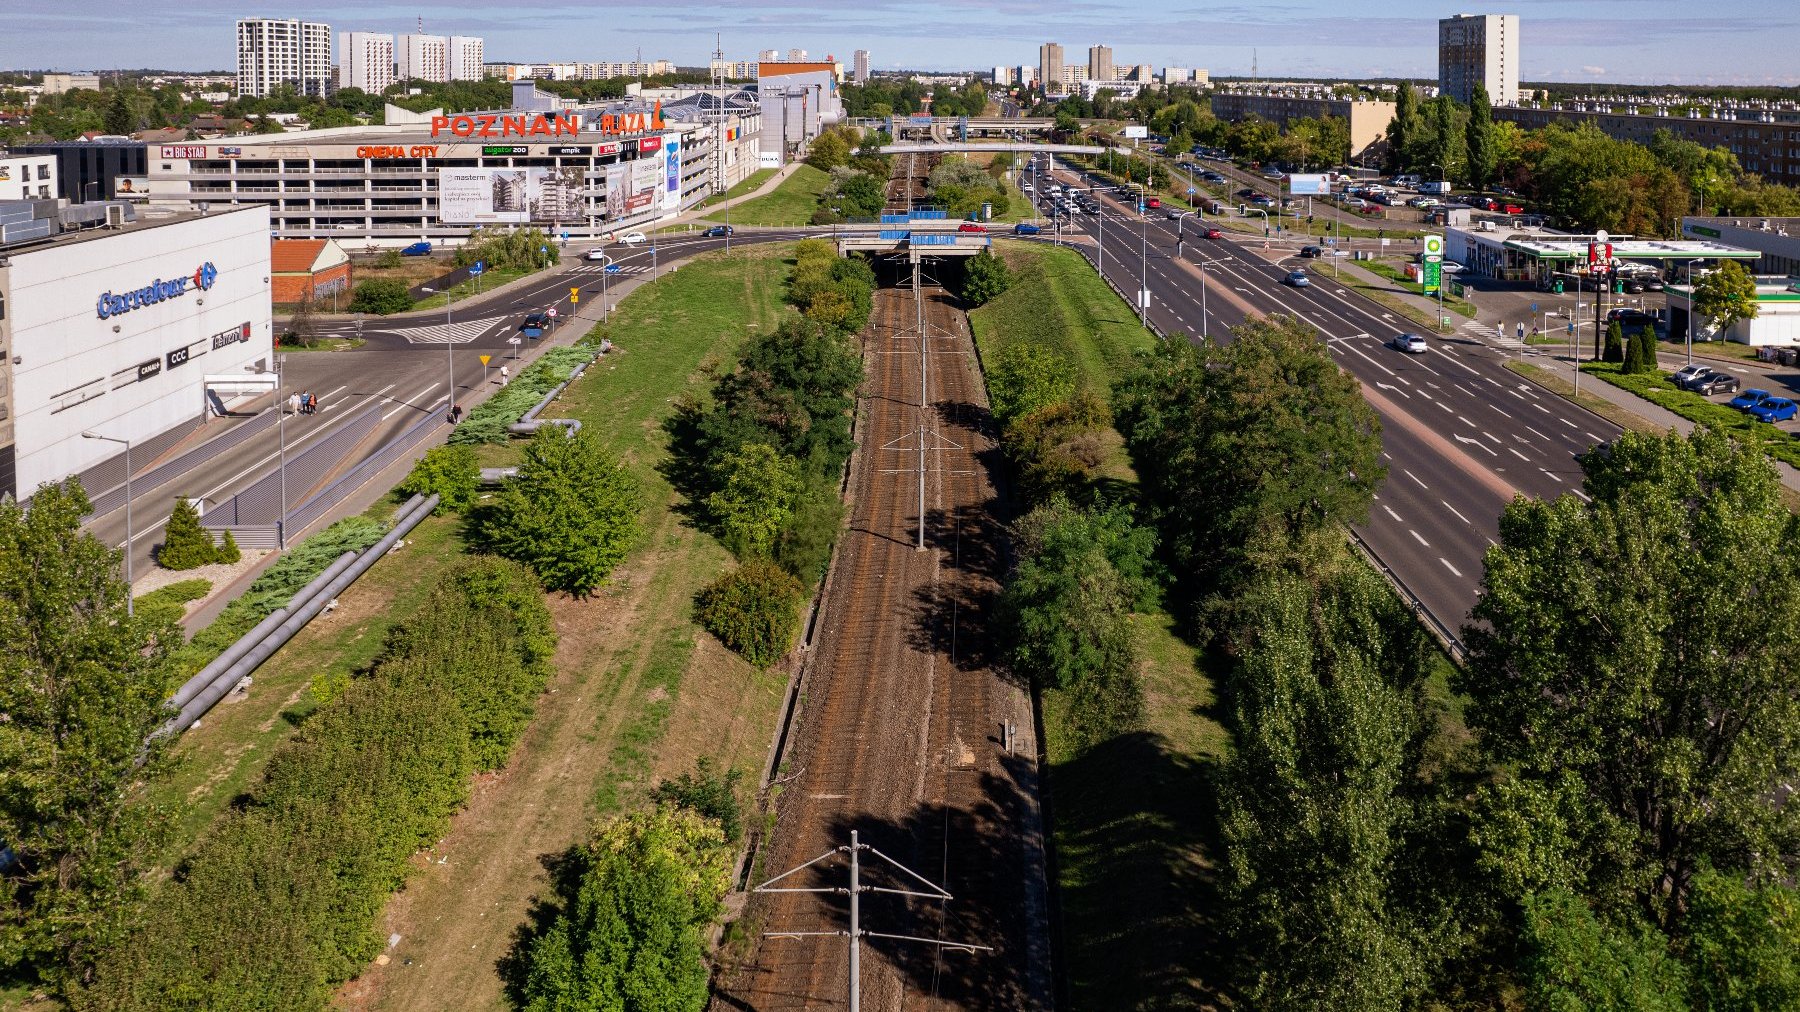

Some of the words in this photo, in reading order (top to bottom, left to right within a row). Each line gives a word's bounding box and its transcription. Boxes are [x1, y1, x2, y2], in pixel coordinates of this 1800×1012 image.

[431, 109, 578, 138] POZNAŃ
[601, 113, 646, 136] PLAZA
[175, 147, 186, 158] BIG
[187, 147, 205, 158] STAR
[357, 146, 405, 159] CINEMA
[410, 145, 439, 158] CITY
[561, 147, 580, 155] empik
[97, 275, 188, 320] Carrefour
[171, 350, 187, 364] CCC
[141, 362, 161, 375] CANAL+
